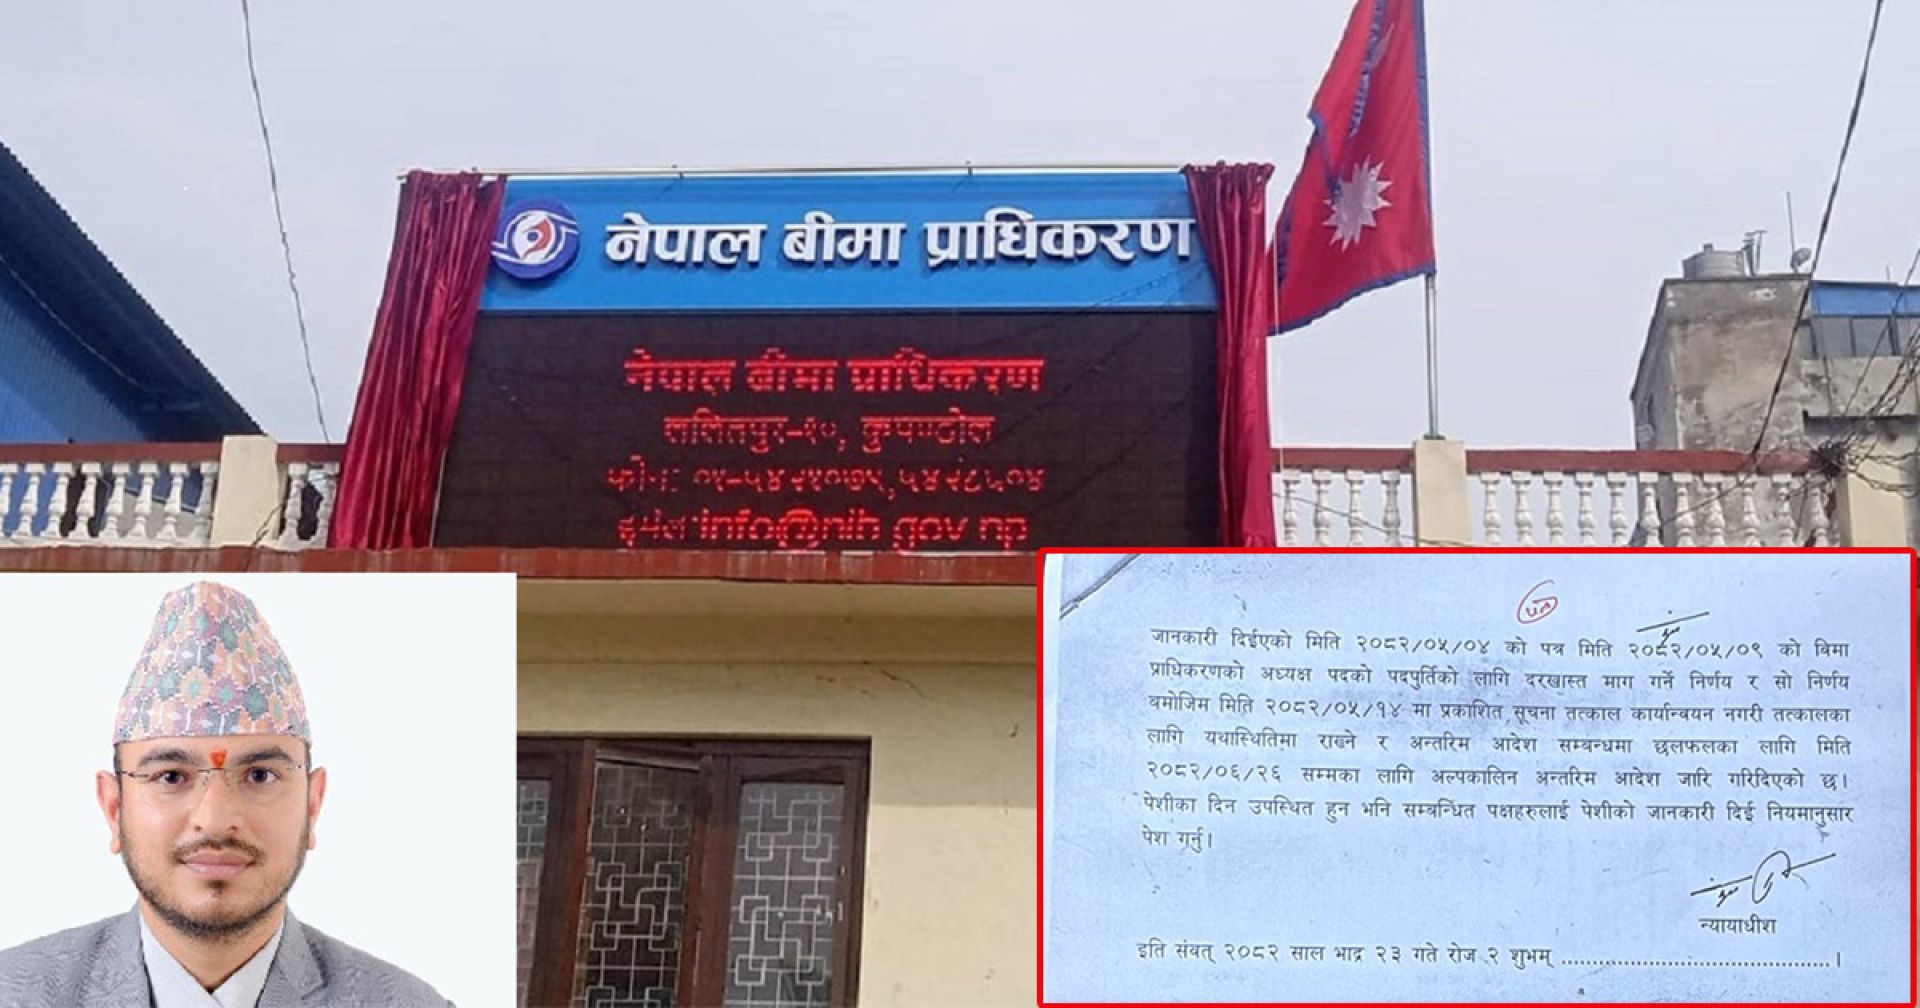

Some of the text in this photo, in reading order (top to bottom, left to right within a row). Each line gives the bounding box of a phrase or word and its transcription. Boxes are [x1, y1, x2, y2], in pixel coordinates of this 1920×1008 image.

[605, 207, 1197, 270] नेपाल बीमा प्राधिकरण
[624, 347, 1045, 392] नेपाल बीमा प्राधिकरण
[1151, 627, 1218, 646] जानकारी
[1305, 630, 1341, 650] मिति
[1504, 636, 1528, 656] को
[1539, 643, 1565, 656] पत्र
[1578, 638, 1613, 658] मिति
[1778, 638, 1802, 657] को
[1149, 657, 1245, 680] प्राधिकरणको
[1261, 667, 1312, 682] अध्यक्ष
[1327, 663, 1373, 684] पदको
[1473, 665, 1510, 690] लागि
[1523, 673, 1588, 693] दरखास्त
[1602, 675, 1635, 693] माग
[1689, 670, 1733, 690] निर्णय
[1747, 675, 1760, 690] र
[1772, 669, 1793, 690] सो
[1807, 669, 1850, 690] निर्णय
[1219, 692, 1255, 716] मिति
[1409, 703, 1432, 718] मा
[1440, 699, 1503, 721] प्रकाशित
[1564, 705, 1622, 725] तत्काल
[1723, 702, 1764, 723] नगरी
[1771, 707, 1851, 722] तत्कालका
[1146, 723, 1184, 749] लागि
[1376, 736, 1389, 751] र
[1410, 728, 1472, 752] अन्तरिम
[1492, 730, 1538, 752] आदेश
[1652, 739, 1739, 757] छलफलका
[1758, 734, 1797, 755] लागि
[1816, 734, 1851, 755] मिति
[1301, 768, 1360, 784] सम्मका
[1376, 763, 1415, 784] लागि
[1432, 764, 1519, 785] अल्पकालिन
[1536, 763, 1597, 787] अन्तरिम
[1615, 766, 1662, 787] आदेश
[1676, 766, 1712, 788] जारि
[1728, 767, 1805, 792] गरिदिएको
[1144, 790, 1198, 813] पेशीका
[1208, 792, 1237, 814] दिन
[1248, 794, 1315, 816] उपस्थित
[1325, 802, 1351, 824] हुन
[1361, 797, 1392, 817] भनि
[1580, 798, 1636, 820] पेशीको
[1646, 800, 1716, 821] जानकारी
[1726, 800, 1757, 823] दिई
[1766, 800, 1854, 830] नियमानुसार
[1142, 821, 1171, 845] पेश
[1698, 913, 1777, 934] न्यायाधीश
[1136, 937, 1554, 970] इति संवत् २०८२ साल भाद्र २३ गते रोज २ शुभम्
